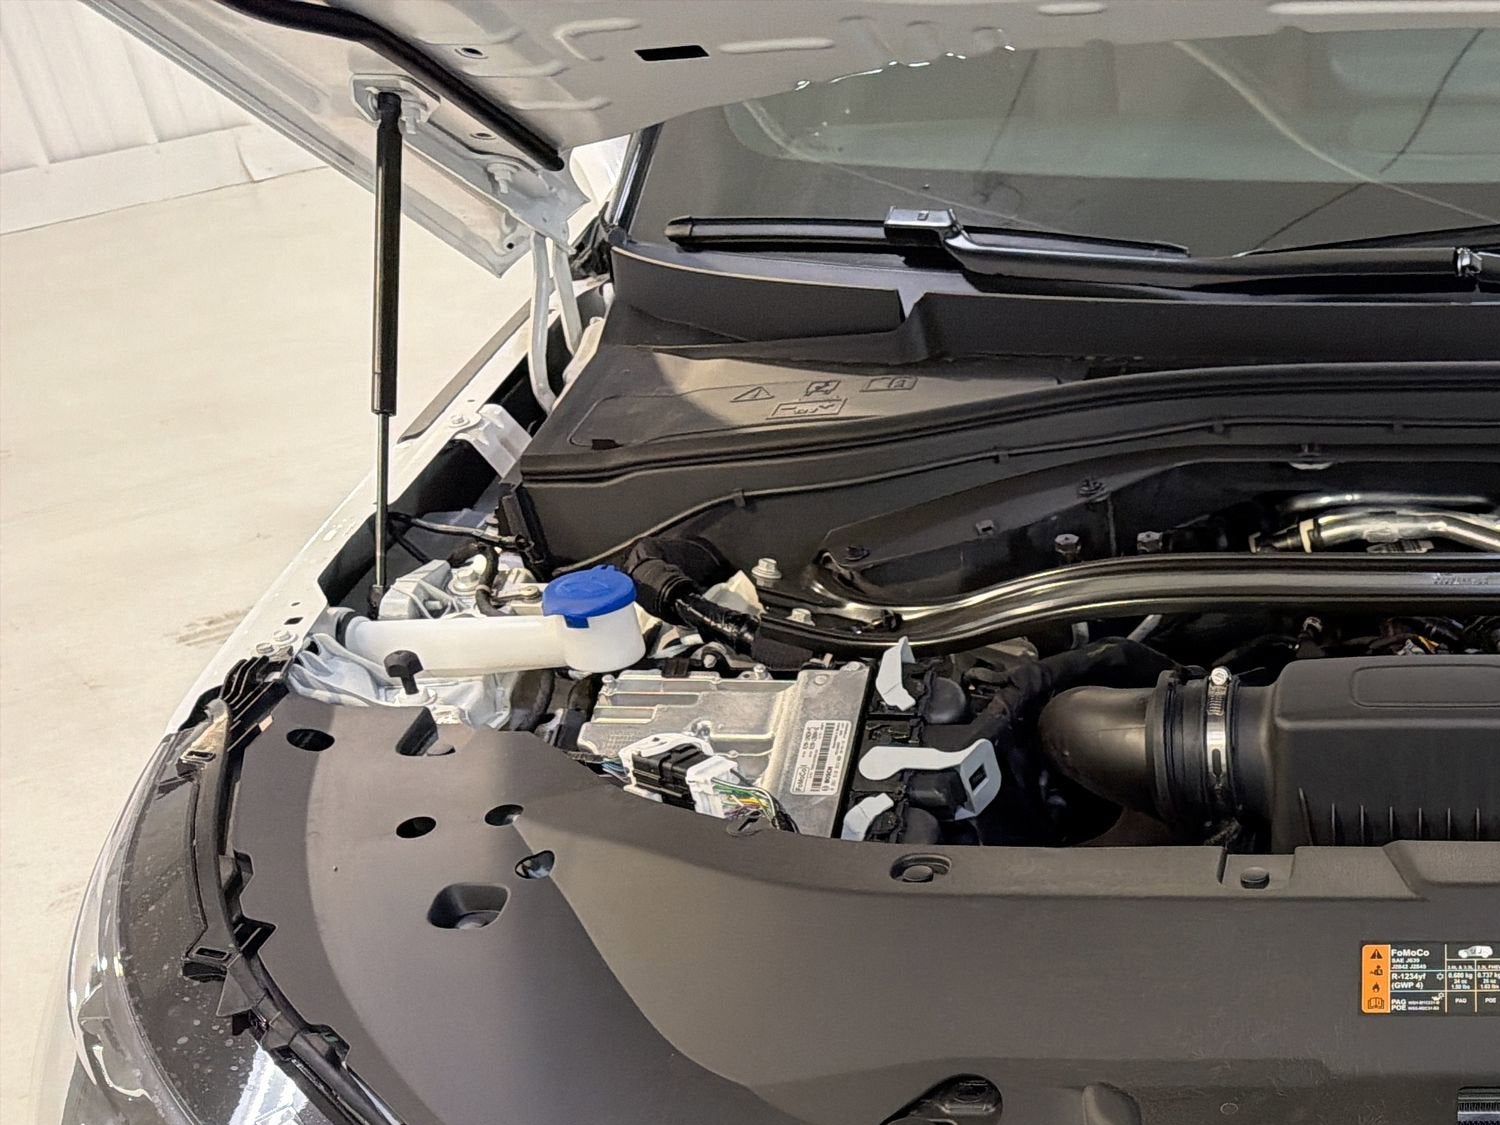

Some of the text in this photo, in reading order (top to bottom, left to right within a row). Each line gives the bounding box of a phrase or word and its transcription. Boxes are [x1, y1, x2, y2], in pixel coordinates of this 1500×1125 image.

[1391, 949, 1430, 957] FoMoCo
[1391, 973, 1426, 981] R-1234yf
[1391, 982, 1424, 990] (GWP 4)
